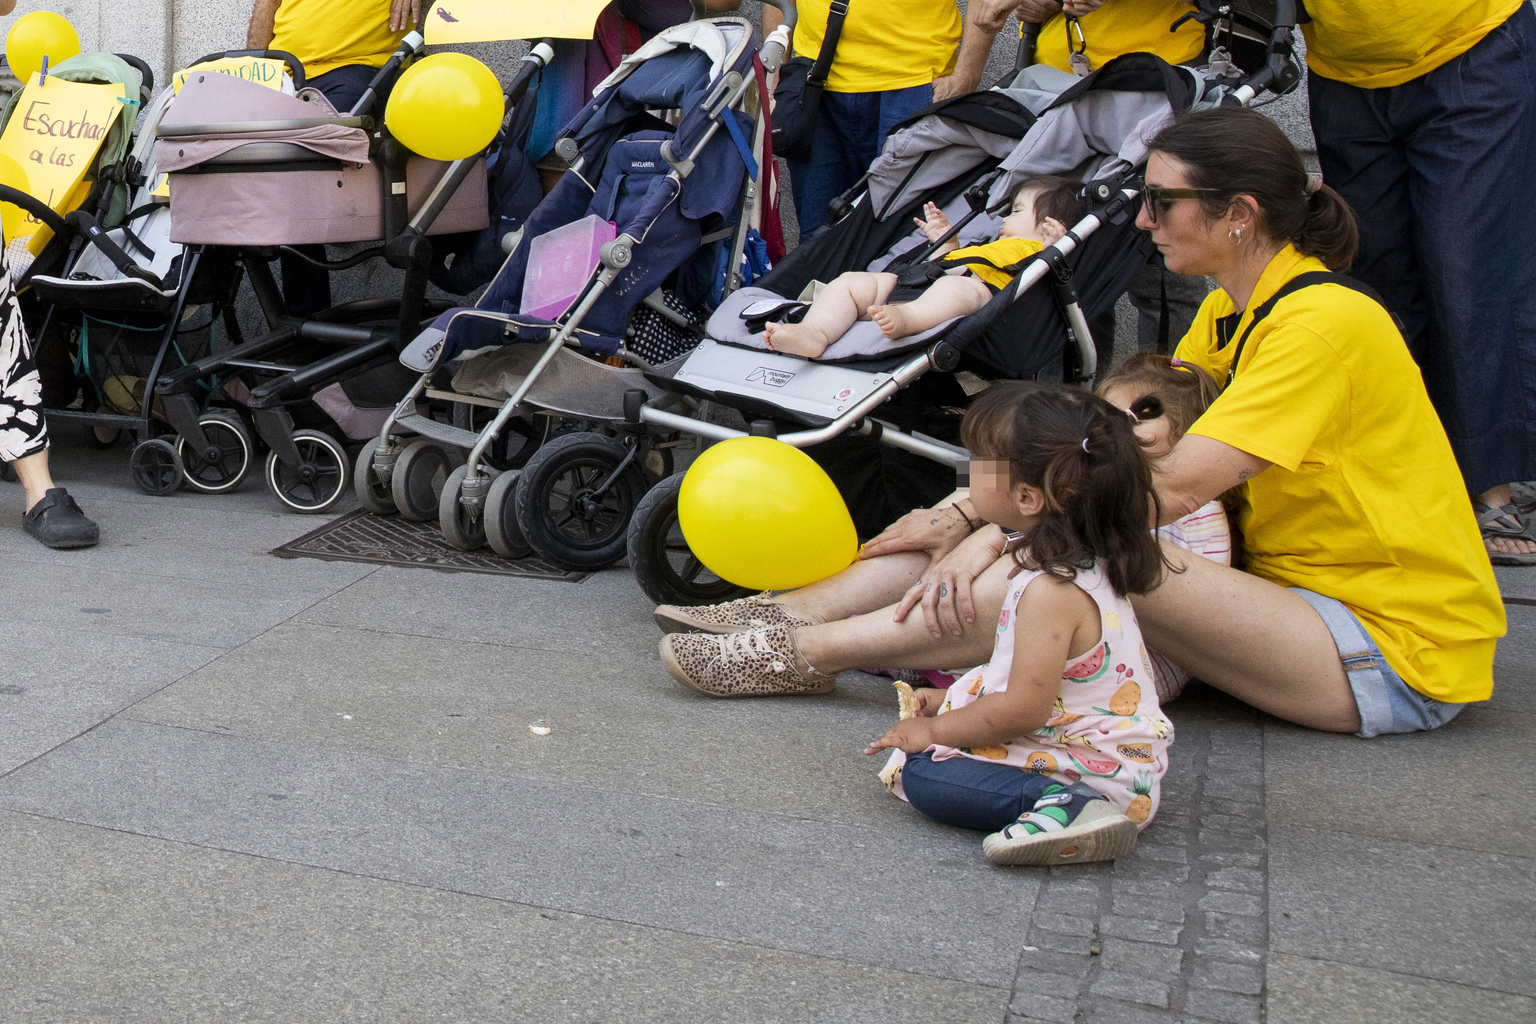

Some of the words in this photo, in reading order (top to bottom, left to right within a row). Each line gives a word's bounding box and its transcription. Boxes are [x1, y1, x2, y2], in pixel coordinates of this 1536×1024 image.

[23, 100, 115, 141] Escuchad
[29, 149, 43, 165] a
[49, 146, 75, 167] las
